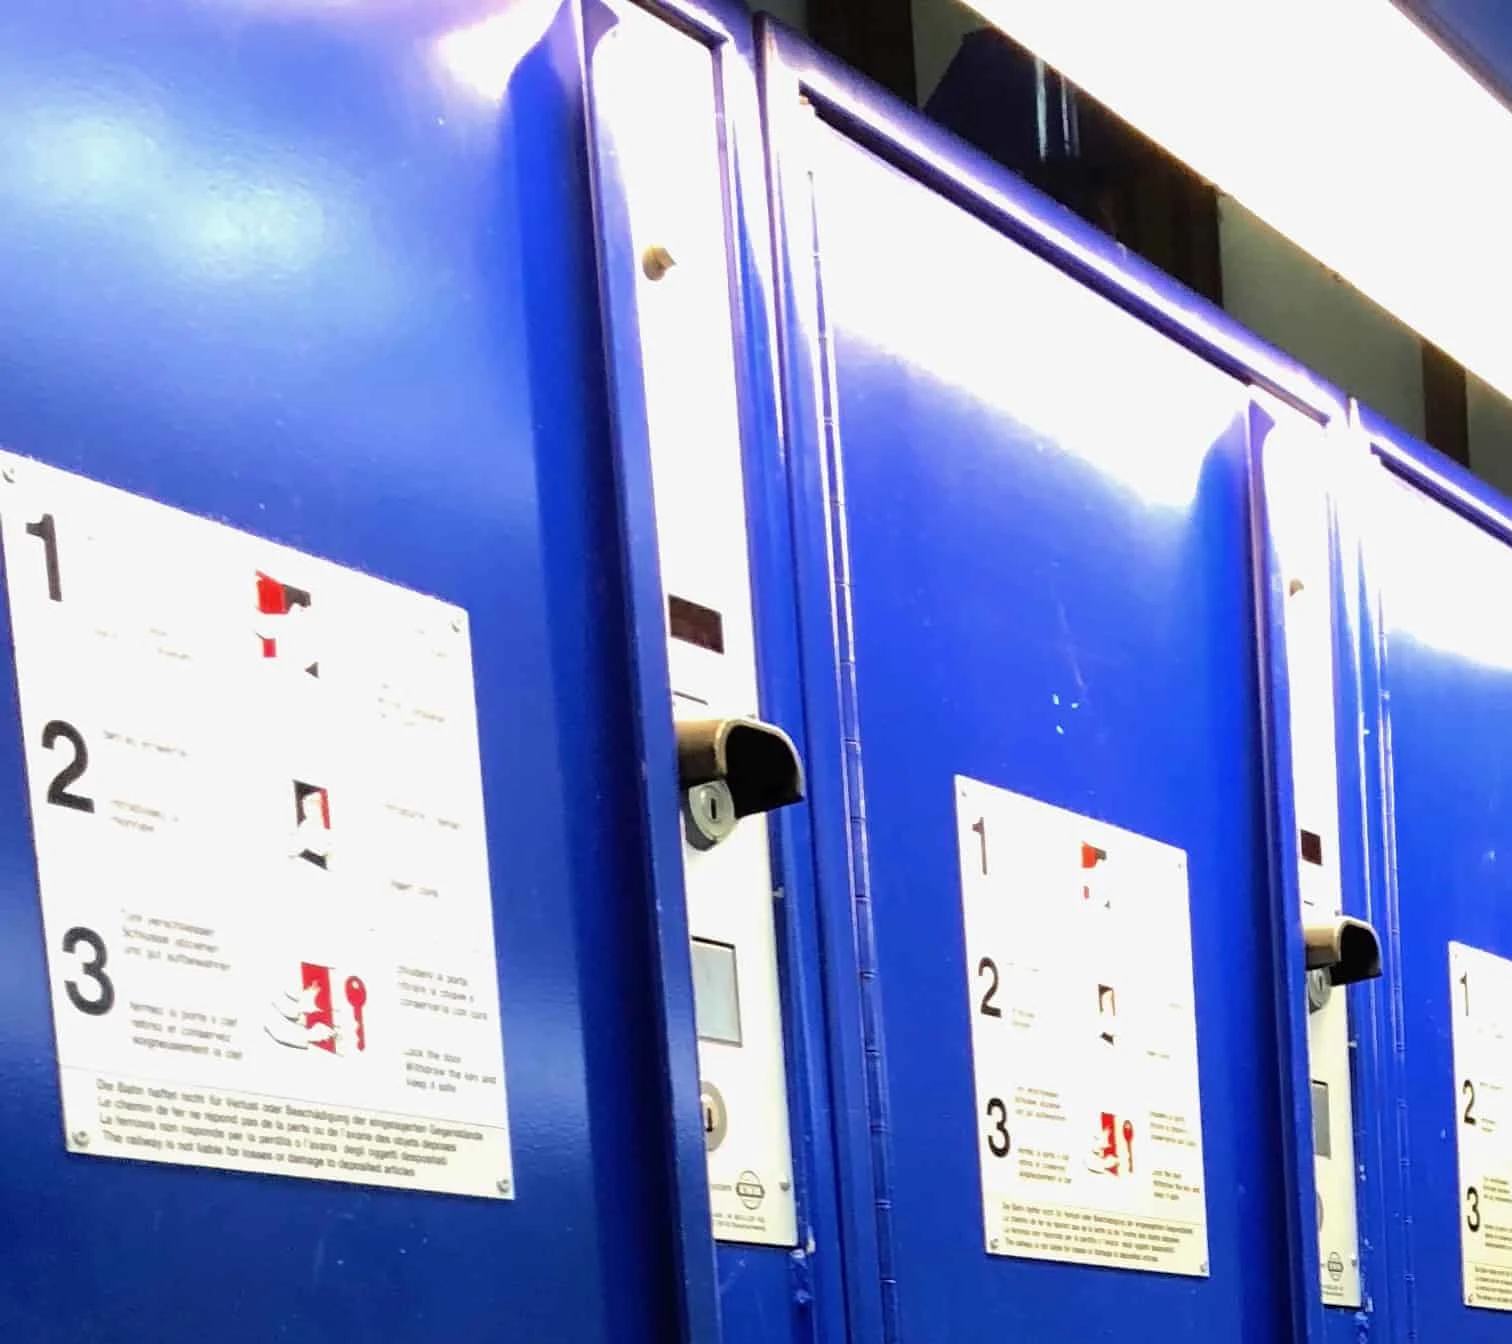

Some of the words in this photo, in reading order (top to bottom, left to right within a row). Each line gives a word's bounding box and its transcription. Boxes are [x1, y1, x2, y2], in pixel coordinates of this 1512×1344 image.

[26, 514, 63, 602] 1
[41, 720, 95, 814] 2
[972, 817, 989, 876] 1
[62, 926, 115, 1017] 3
[978, 957, 1003, 1019] 2
[1460, 971, 1469, 1016] 1
[986, 1097, 1012, 1159] 3
[1462, 1079, 1477, 1126] 2
[1466, 1186, 1482, 1233] 3
